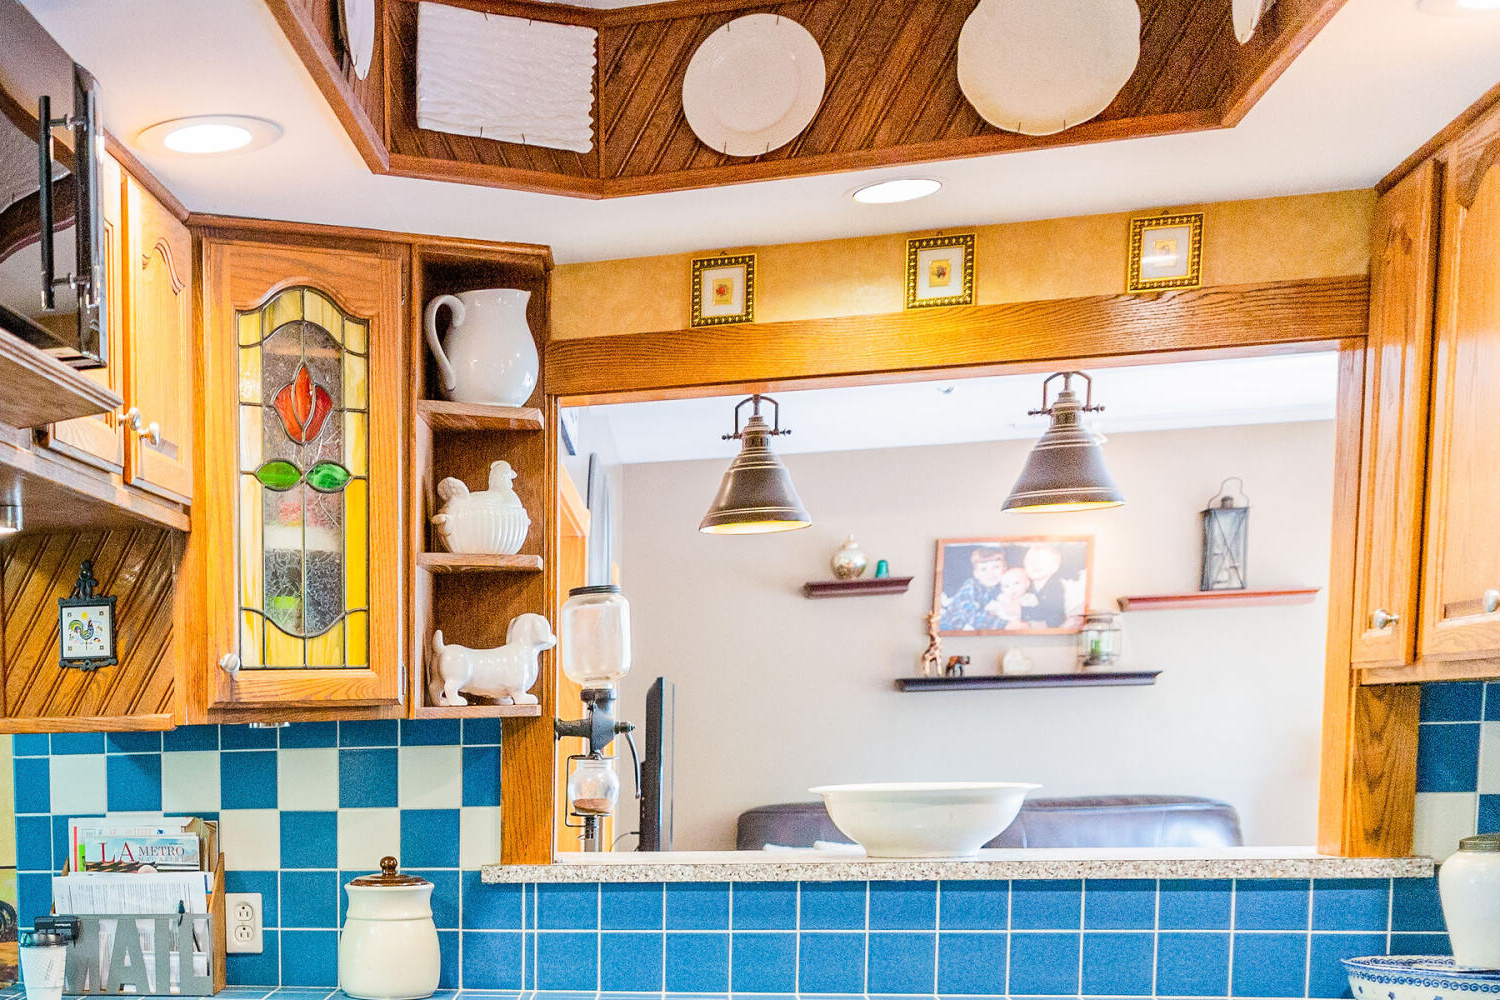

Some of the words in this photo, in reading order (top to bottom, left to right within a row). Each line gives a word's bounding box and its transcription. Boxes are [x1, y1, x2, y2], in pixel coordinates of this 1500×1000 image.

[99, 841, 135, 863] LA
[138, 845, 185, 857] METRO
[61, 918, 212, 994] MAIL
